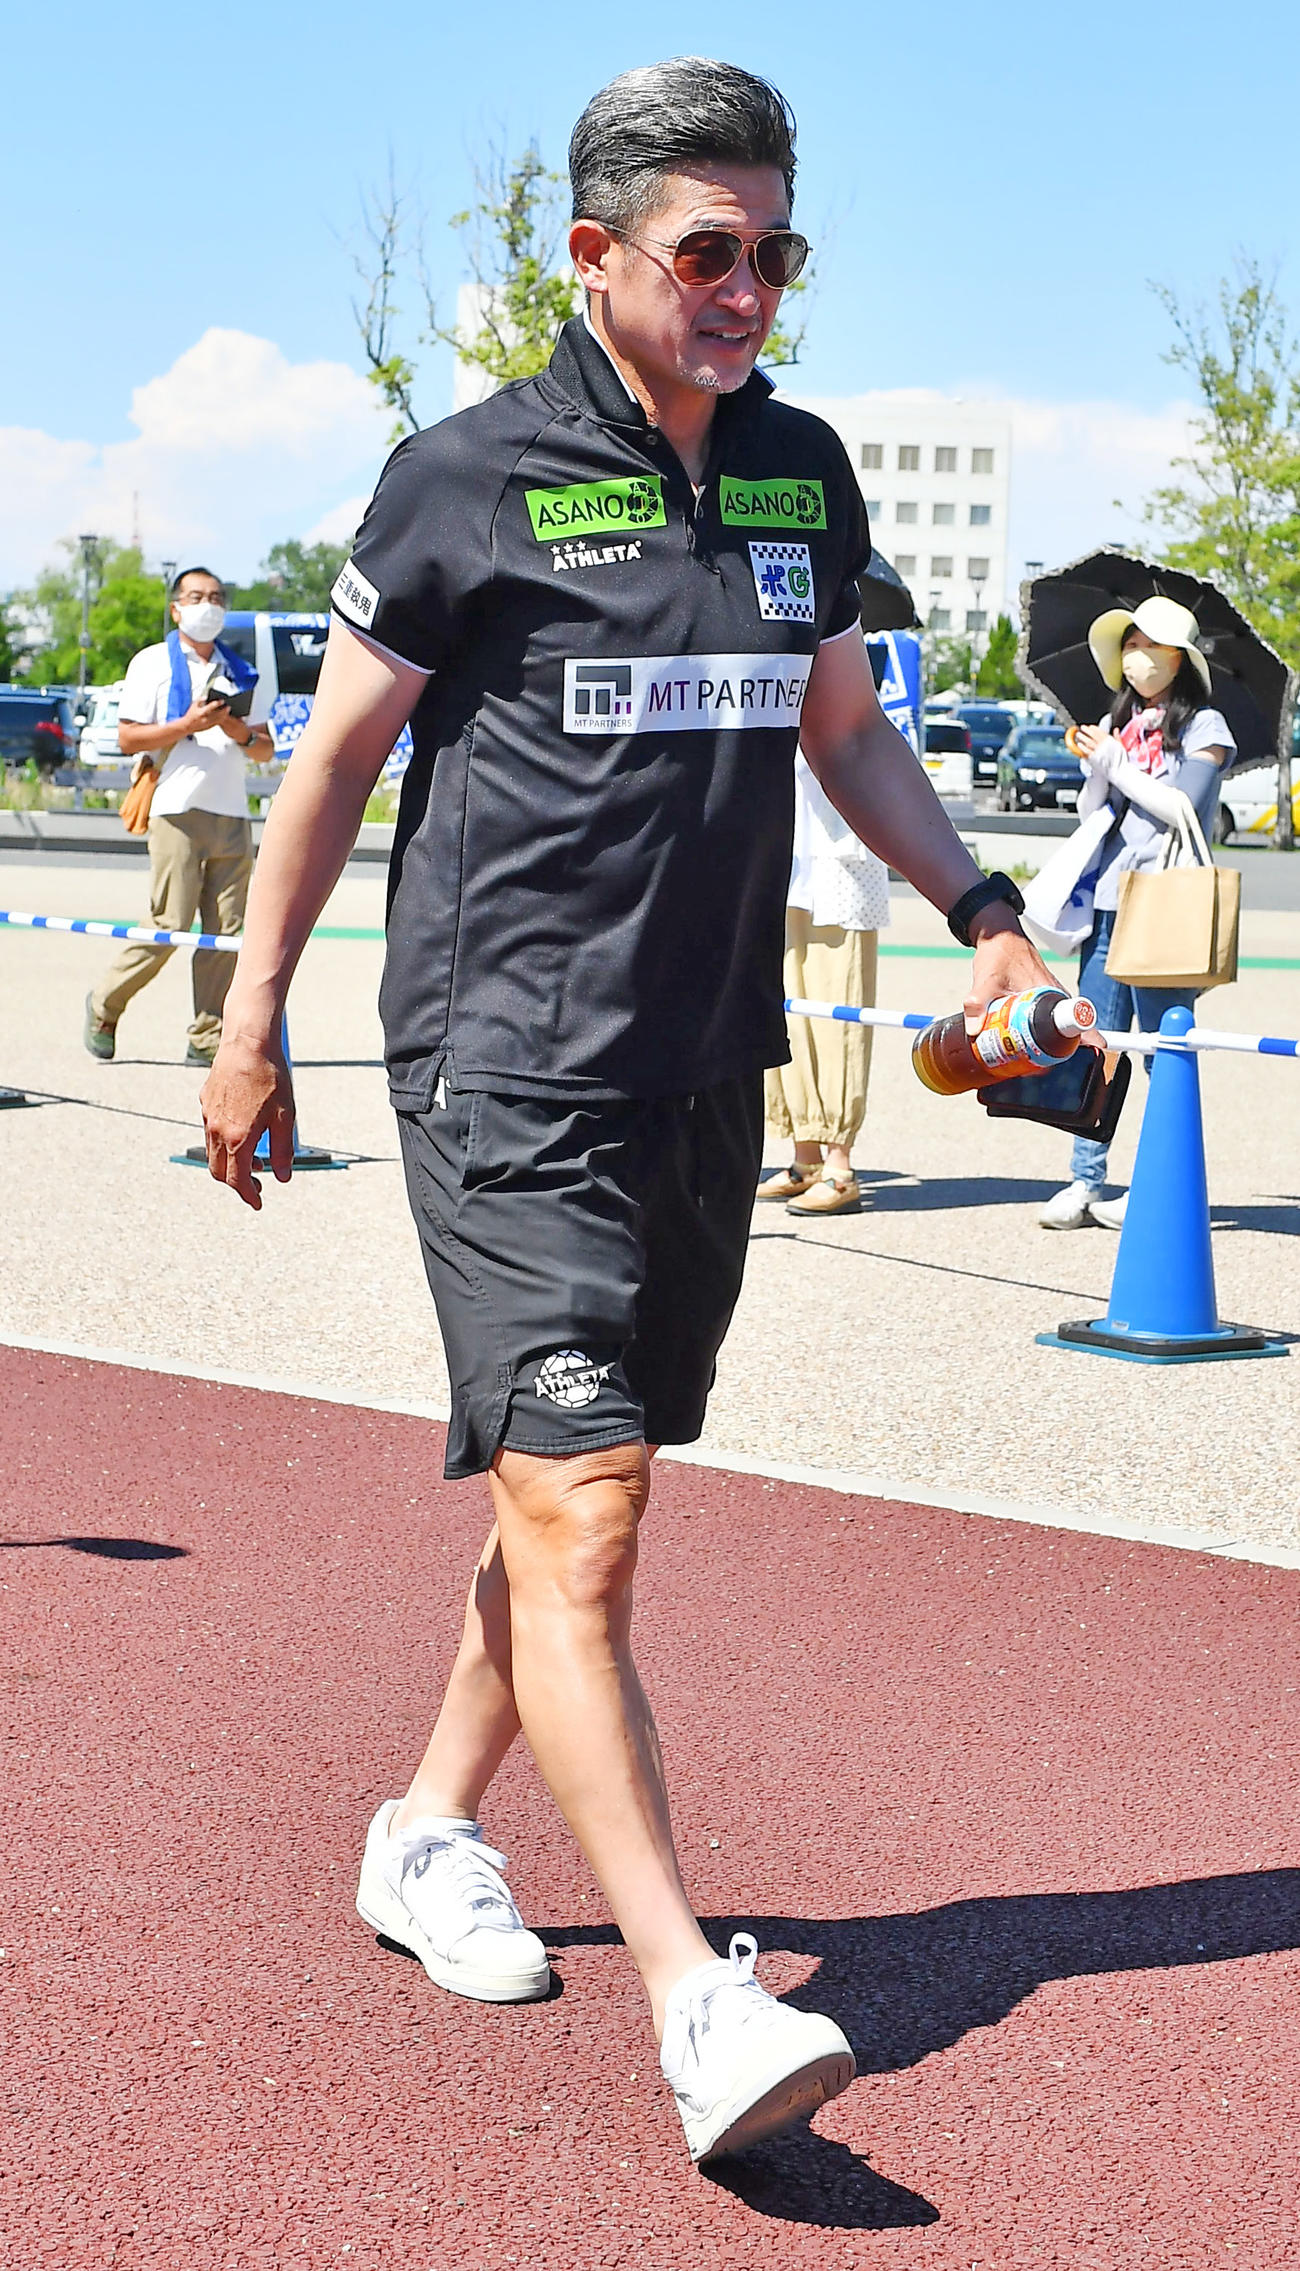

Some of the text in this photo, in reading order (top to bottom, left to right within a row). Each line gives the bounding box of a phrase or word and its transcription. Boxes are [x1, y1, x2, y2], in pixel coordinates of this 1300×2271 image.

[538, 494, 624, 528] ASANO
[724, 495, 795, 516] ASANO
[553, 542, 641, 572] ATHLETA
[649, 681, 690, 712] MT
[575, 719, 632, 728] MT PARTNERS
[533, 1364, 612, 1398] ATHLETA
